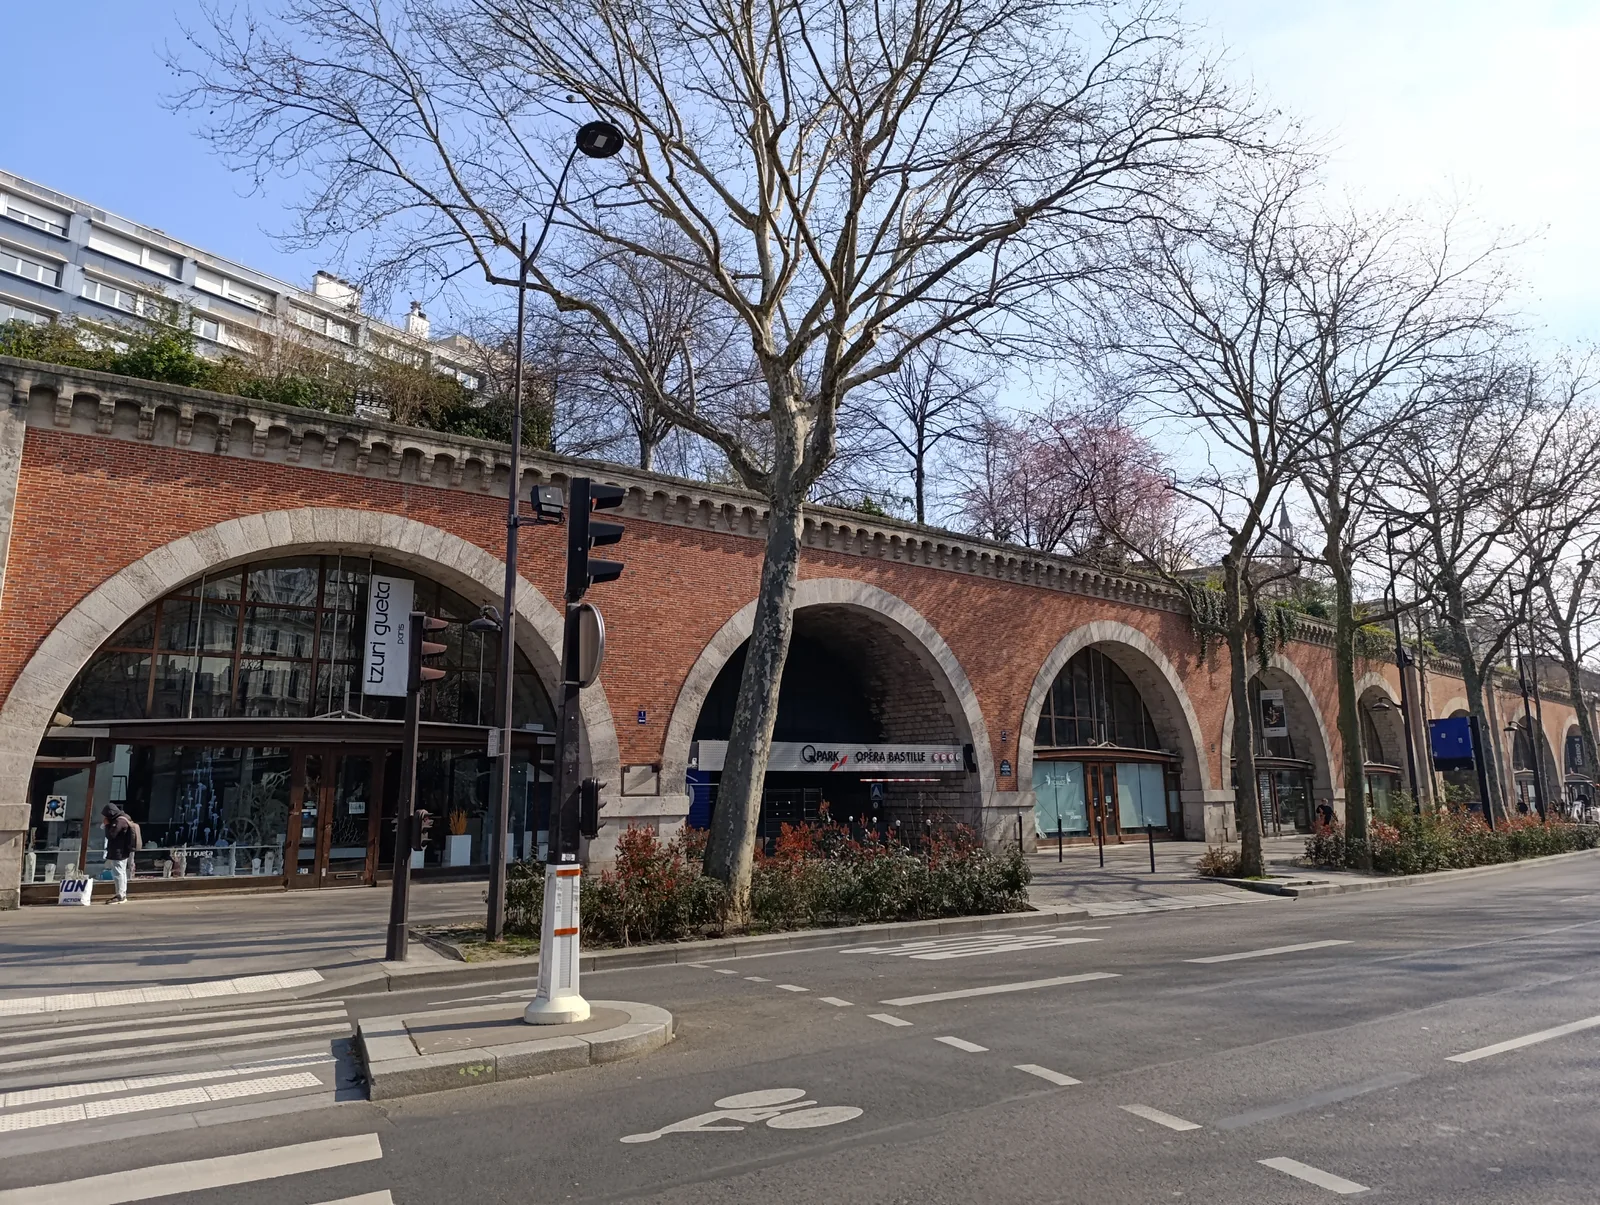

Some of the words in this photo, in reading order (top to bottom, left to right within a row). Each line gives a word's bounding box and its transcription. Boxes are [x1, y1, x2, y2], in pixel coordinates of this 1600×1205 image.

[373, 581, 391, 636] gueta
[397, 623, 405, 645] paris
[366, 641, 386, 684] tzuri
[855, 749, 886, 763] OPÉRA
[888, 751, 926, 763] BASTILLE
